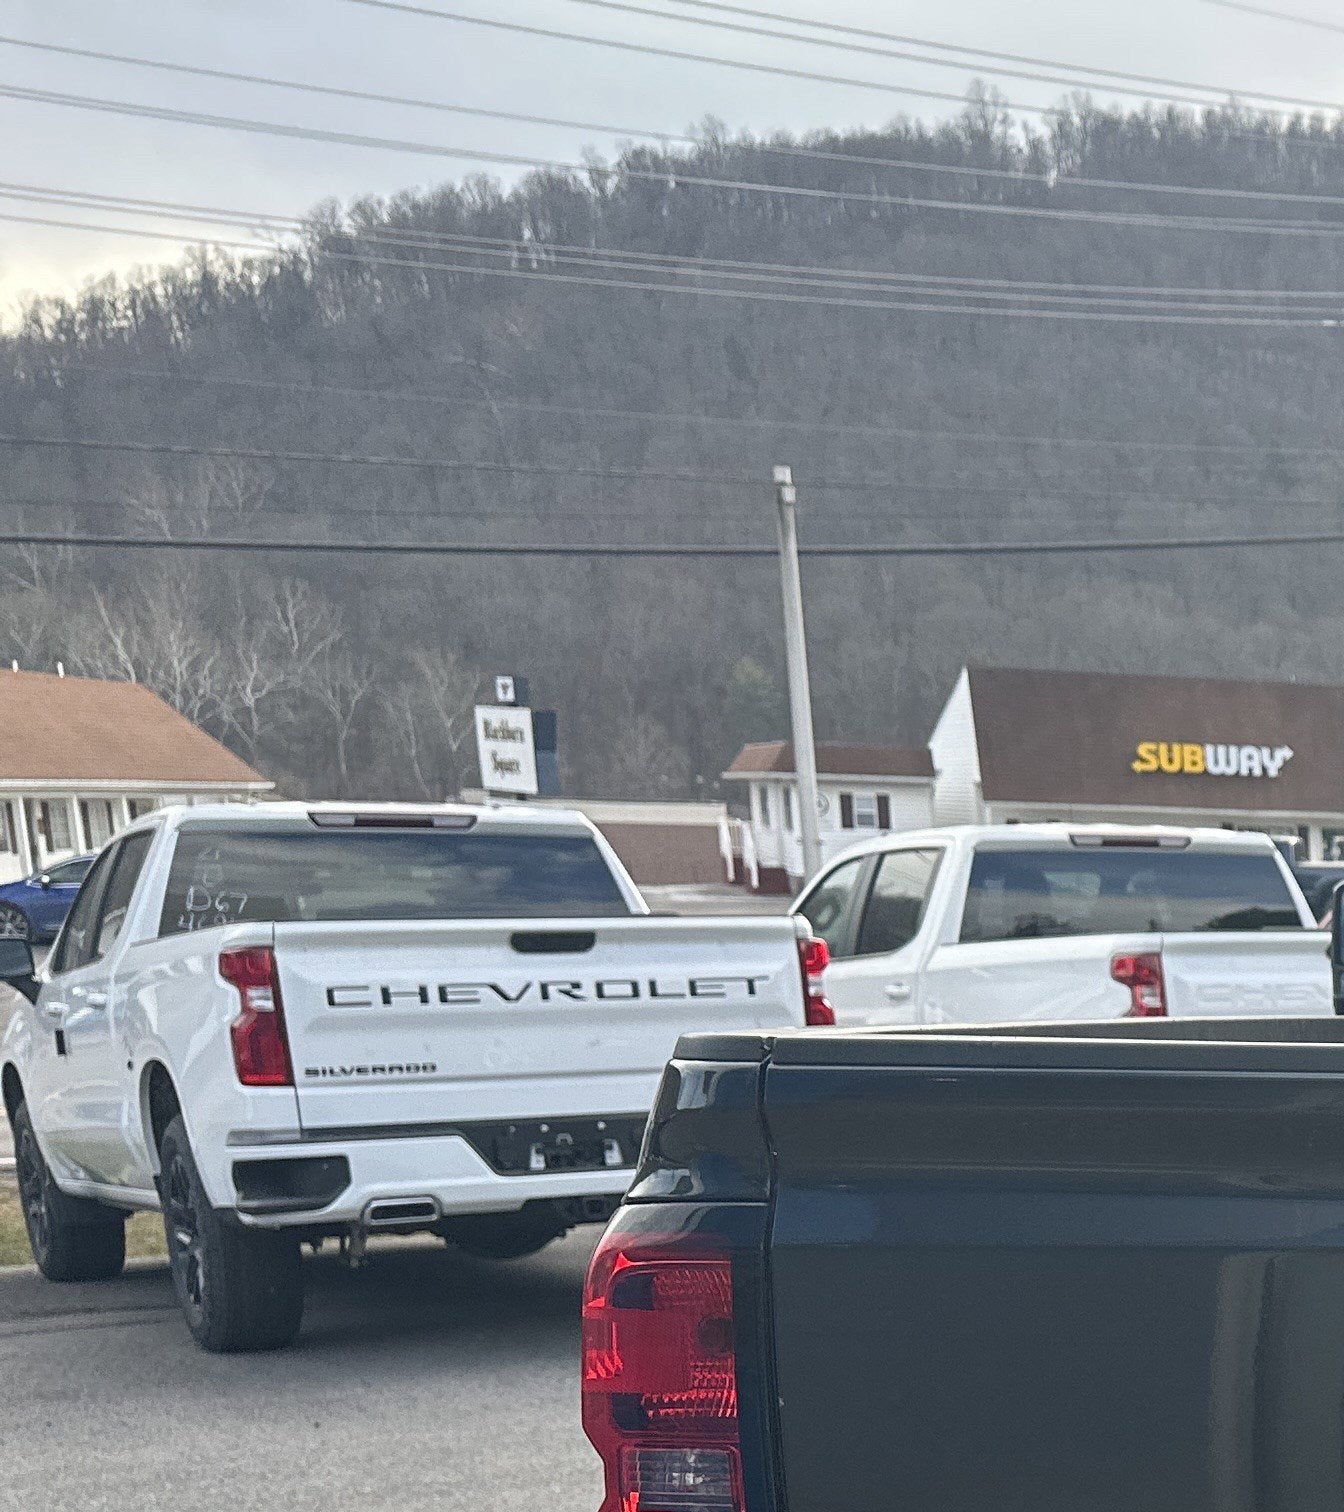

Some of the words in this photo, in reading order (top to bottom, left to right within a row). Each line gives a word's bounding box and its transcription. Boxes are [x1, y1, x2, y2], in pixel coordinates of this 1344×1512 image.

[1132, 741, 1294, 778] SUBWAY
[325, 975, 770, 1009] CHEVROLET
[304, 1062, 438, 1078] SILVERADO
